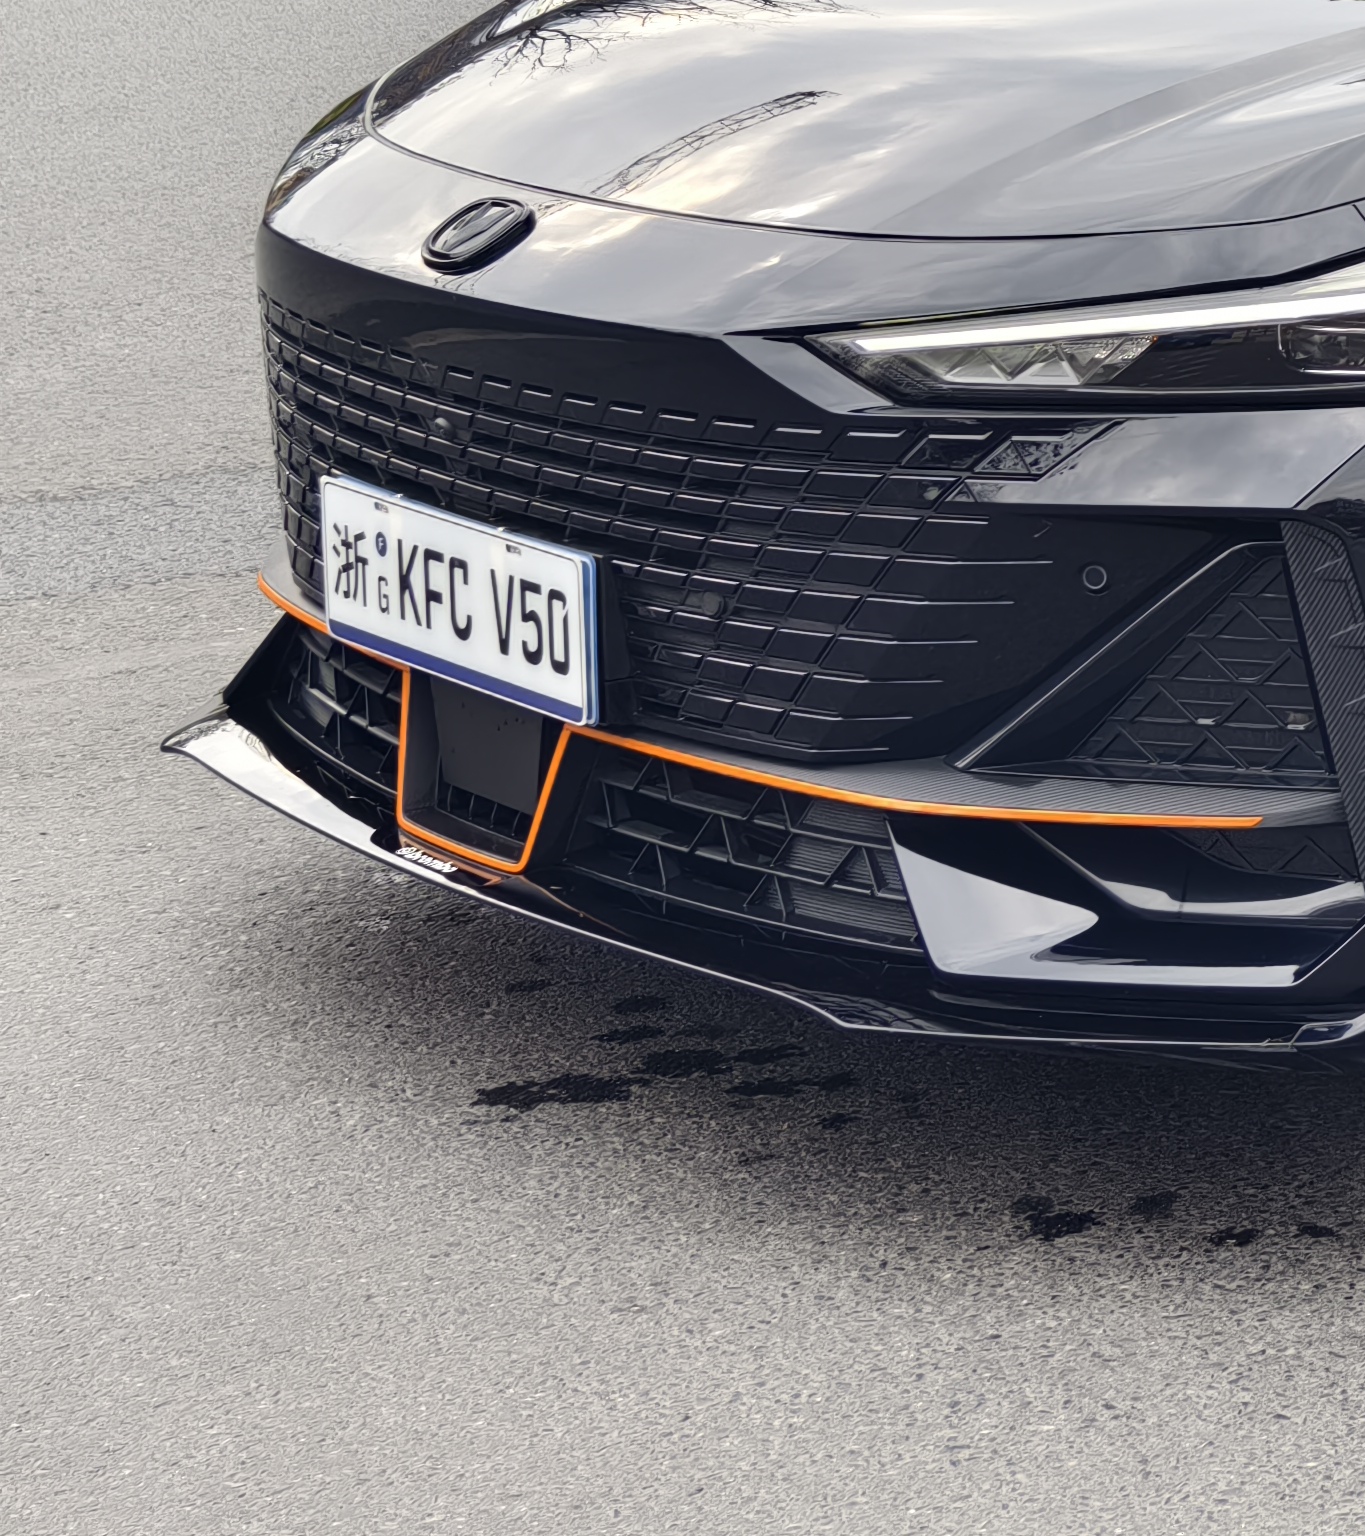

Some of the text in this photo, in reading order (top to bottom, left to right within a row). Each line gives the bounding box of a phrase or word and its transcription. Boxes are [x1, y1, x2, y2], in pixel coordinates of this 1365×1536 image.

[332, 523, 369, 608] 浙
[397, 538, 571, 677] KFC V50
